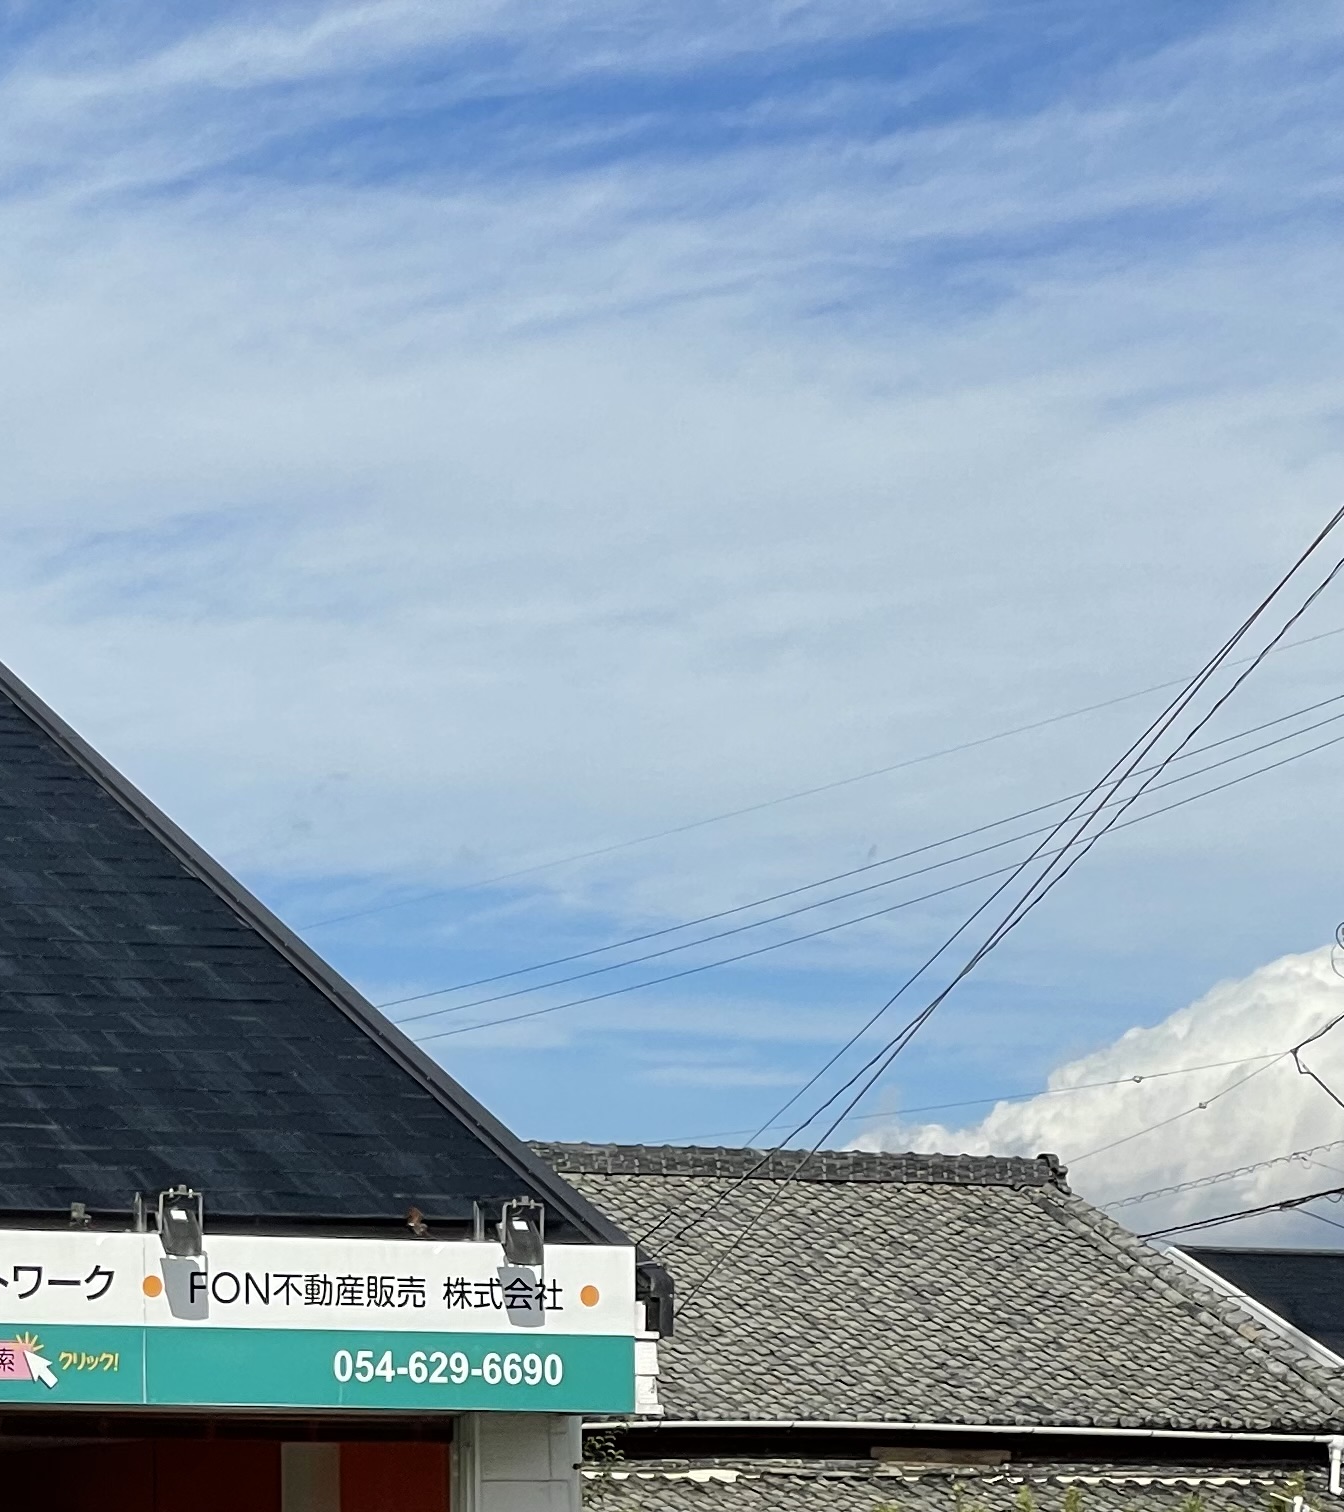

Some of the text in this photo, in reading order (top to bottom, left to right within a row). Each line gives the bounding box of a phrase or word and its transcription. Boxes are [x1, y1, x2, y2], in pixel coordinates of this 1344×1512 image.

[189, 1271, 564, 1311] FON不動産販売 株式会社
[59, 1352, 120, 1372] クリック!
[333, 1350, 564, 1386] 054-629-6690
